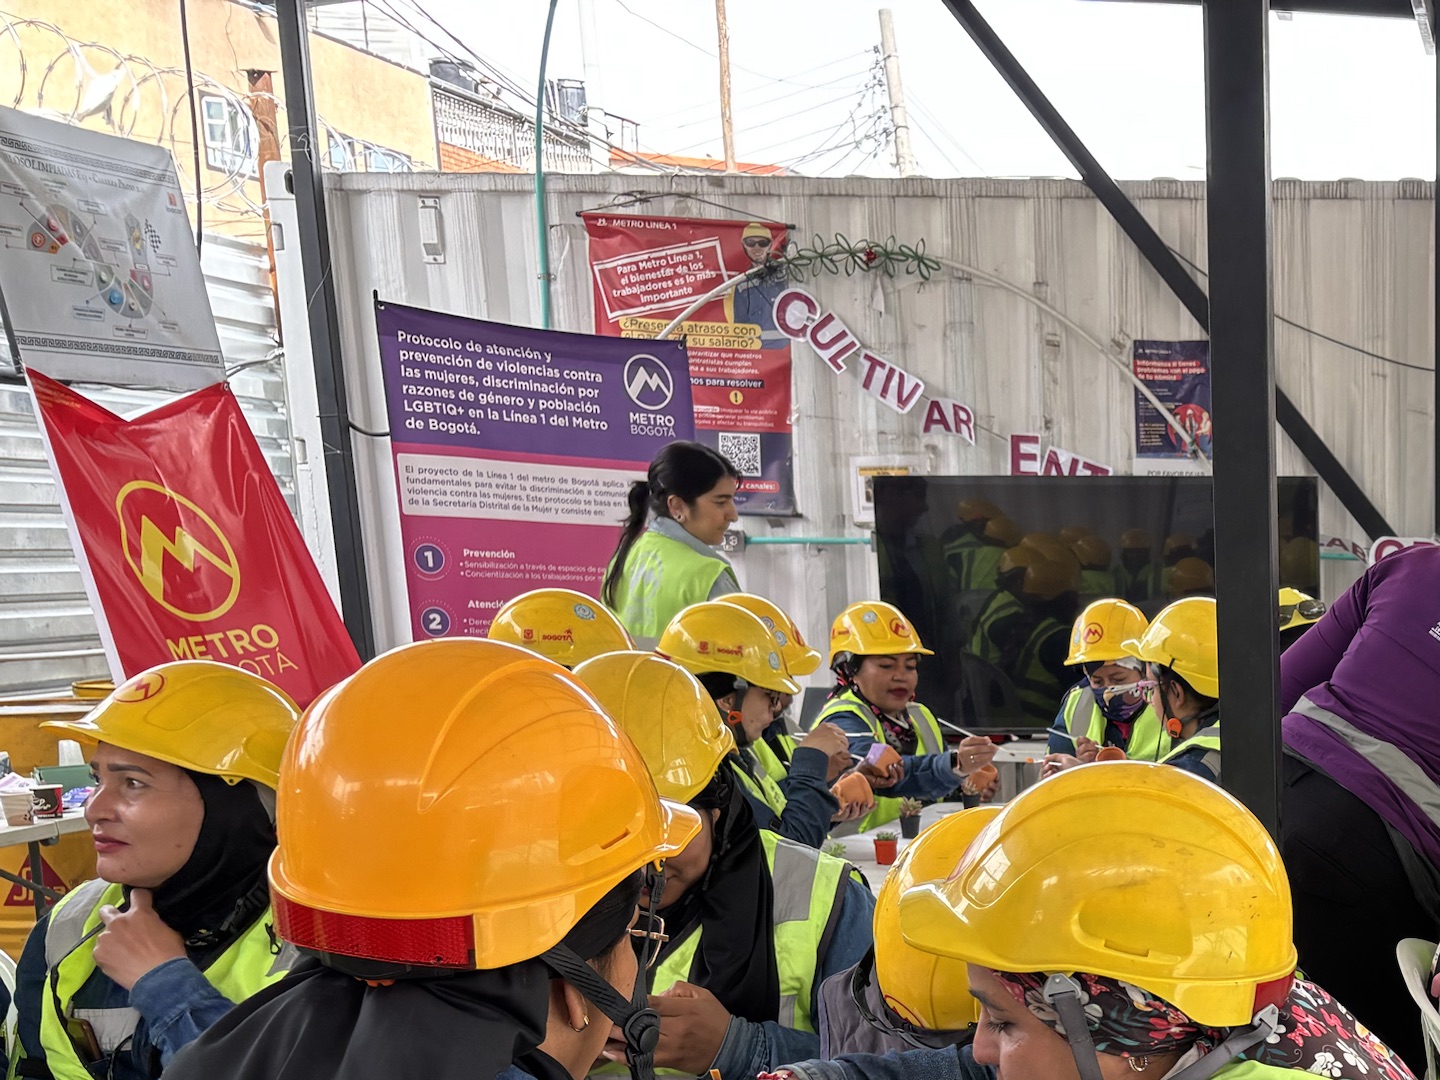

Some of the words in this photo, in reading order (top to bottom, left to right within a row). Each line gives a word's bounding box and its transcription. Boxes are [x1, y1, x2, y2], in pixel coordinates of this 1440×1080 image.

[613, 219, 645, 228] METRO
[617, 263, 637, 275] Para
[639, 258, 667, 271] Metro
[668, 253, 693, 265] Línea
[695, 251, 703, 261] 1,
[612, 279, 673, 298] trabajadores
[673, 276, 685, 286] es
[686, 272, 695, 284] lo
[697, 269, 716, 282] más
[620, 276, 629, 286] el
[631, 267, 674, 284] bienestar
[675, 264, 688, 275] de
[690, 261, 704, 272] los
[686, 323, 729, 335] atrasos
[733, 325, 756, 336] con
[397, 330, 462, 351] Protocolo
[466, 340, 482, 353] de
[486, 344, 541, 361] atención
[544, 352, 552, 363] y
[692, 338, 705, 346] su
[709, 336, 754, 348] salario?
[399, 350, 473, 369] prevención
[476, 358, 493, 371] de
[497, 361, 560, 379] violencias
[563, 368, 603, 384] contra
[718, 367, 760, 375] trabajadores.
[725, 359, 752, 367] cumplan
[776, 292, 974, 441] CULTIVAR
[400, 364, 421, 379] las
[424, 367, 479, 388] mujeres,
[482, 374, 575, 396] discriminación
[578, 386, 600, 399] por
[705, 379, 724, 387] para
[727, 379, 762, 388] resolver
[402, 383, 456, 400] razones
[458, 387, 475, 402] de
[478, 390, 525, 407] género
[528, 397, 535, 410] y
[538, 397, 601, 414] población
[404, 399, 465, 416] LGBTIQ+
[468, 408, 485, 420] en
[487, 408, 500, 421] la
[502, 409, 537, 425] Línea
[540, 413, 547, 425] 1
[549, 412, 569, 428] del
[572, 417, 609, 431] Metro
[629, 412, 675, 428] METRO
[405, 416, 424, 430] de
[428, 417, 481, 436] Bogotá.
[630, 424, 676, 439] BOGOTÁ
[405, 465, 414, 475] El
[418, 466, 459, 478] proyecto
[462, 468, 473, 477] de
[476, 469, 484, 478] la
[486, 470, 508, 481] Línea
[516, 473, 530, 482] del
[532, 475, 555, 484] metro
[558, 476, 569, 485] de
[571, 477, 599, 488] Bogotá
[602, 479, 624, 489] aplica
[406, 475, 472, 489] fundamentales
[475, 481, 493, 491] para
[495, 482, 517, 492] evitar
[519, 483, 527, 492] la
[529, 484, 585, 496] discriminación
[407, 487, 448, 498] violencia
[450, 490, 478, 500] contra
[479, 491, 491, 500] las
[493, 492, 525, 503] mujeres.
[526, 493, 543, 504] Este
[544, 495, 582, 507] protocolo
[583, 498, 592, 506] se
[593, 498, 611, 508] basa
[612, 500, 622, 508] en
[408, 496, 420, 506] de
[422, 497, 430, 506] la
[432, 498, 477, 510] Secretaría
[479, 500, 510, 511] Distrital
[512, 502, 521, 512] de
[523, 503, 530, 512] la
[531, 504, 552, 515] Mujer
[561, 507, 592, 517] consiste
[424, 550, 434, 568] 1
[463, 548, 516, 560] Prevención
[464, 560, 518, 571] Sensibilización
[525, 563, 546, 572] través
[548, 563, 557, 572] de
[558, 564, 586, 574] espacios
[587, 565, 596, 574] de
[465, 569, 524, 581] Concientización
[531, 572, 541, 580] los
[542, 572, 584, 582] trabajadores
[585, 574, 596, 583] por
[467, 599, 506, 610] Atenció
[428, 613, 443, 630] 2
[166, 624, 279, 661] METRO
